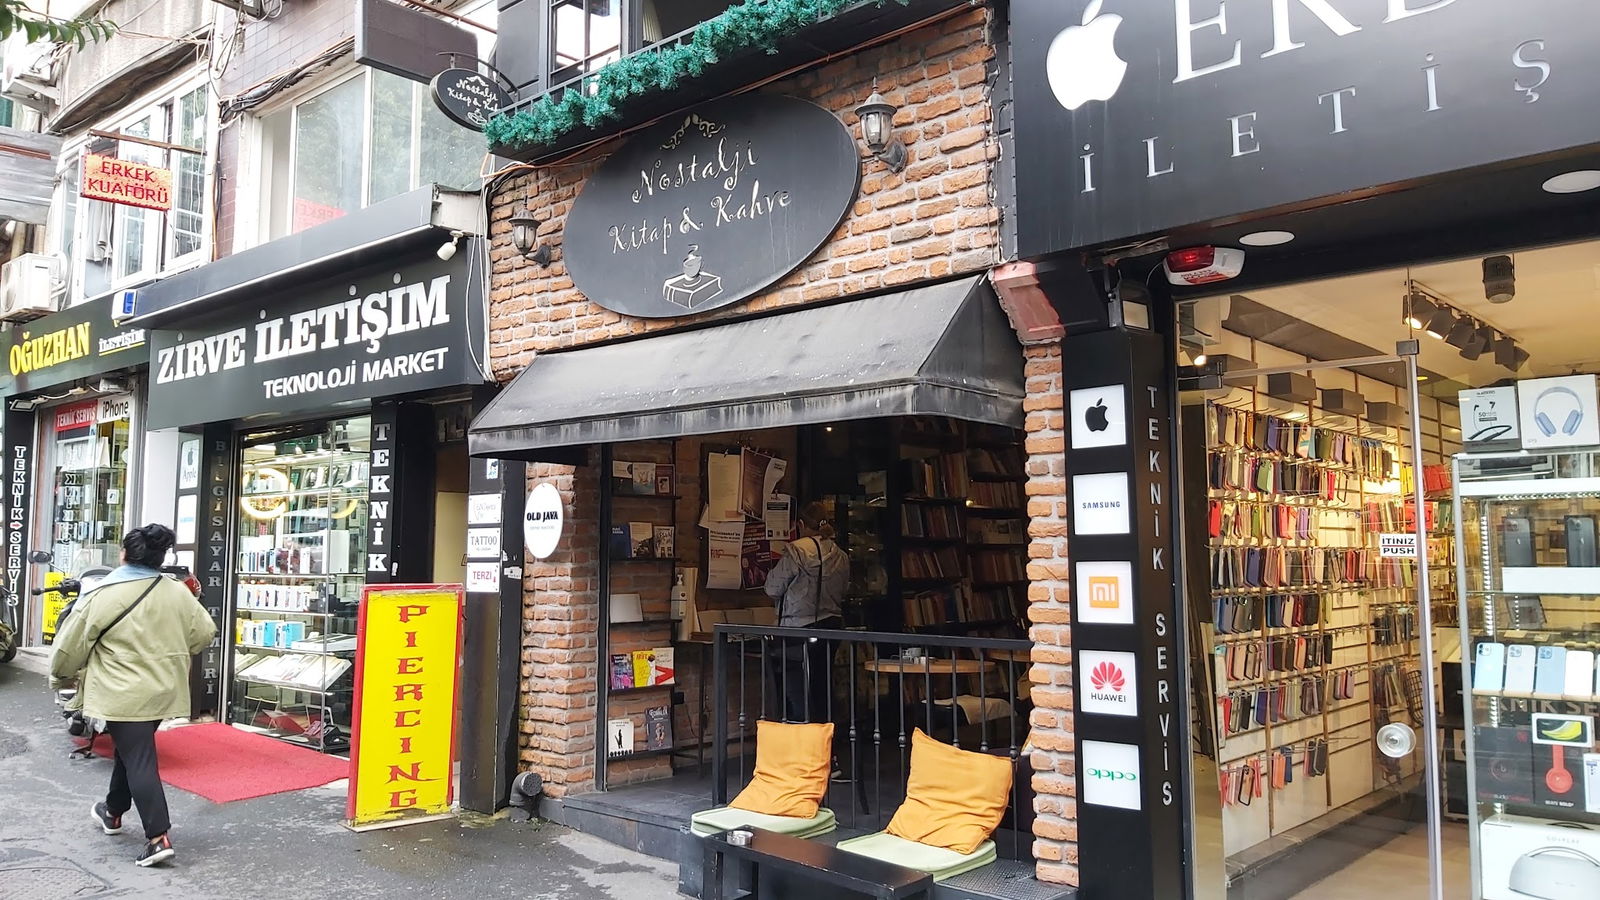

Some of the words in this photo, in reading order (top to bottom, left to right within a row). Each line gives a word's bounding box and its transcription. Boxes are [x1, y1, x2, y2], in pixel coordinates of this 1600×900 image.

[87, 178, 168, 204] KUAFÖRÜ
[100, 160, 156, 183] ERKEK
[631, 136, 759, 203] Nostalji
[609, 216, 673, 255] Kitap
[679, 206, 703, 235] &
[711, 178, 792, 227] Kahve
[9, 321, 91, 377] OĞUZHAN
[156, 327, 246, 385] ZİRVE
[253, 272, 451, 364] İLETİŞİM
[263, 360, 357, 399] TEKNOLOJİ
[362, 347, 449, 383] MARKET
[102, 400, 129, 419] iPhone
[367, 423, 391, 573] TEKNİK
[1082, 501, 1121, 509] SAMSUNG
[1147, 385, 1164, 571] TEKNİK
[470, 535, 498, 546] TATTOO
[526, 511, 541, 521] OLD
[542, 510, 559, 523] JAVA
[203, 606, 221, 695] TMİRİ
[385, 604, 443, 809] PIERCING
[1091, 692, 1127, 703] HUAWEI
[1155, 612, 1173, 806] SERVİS
